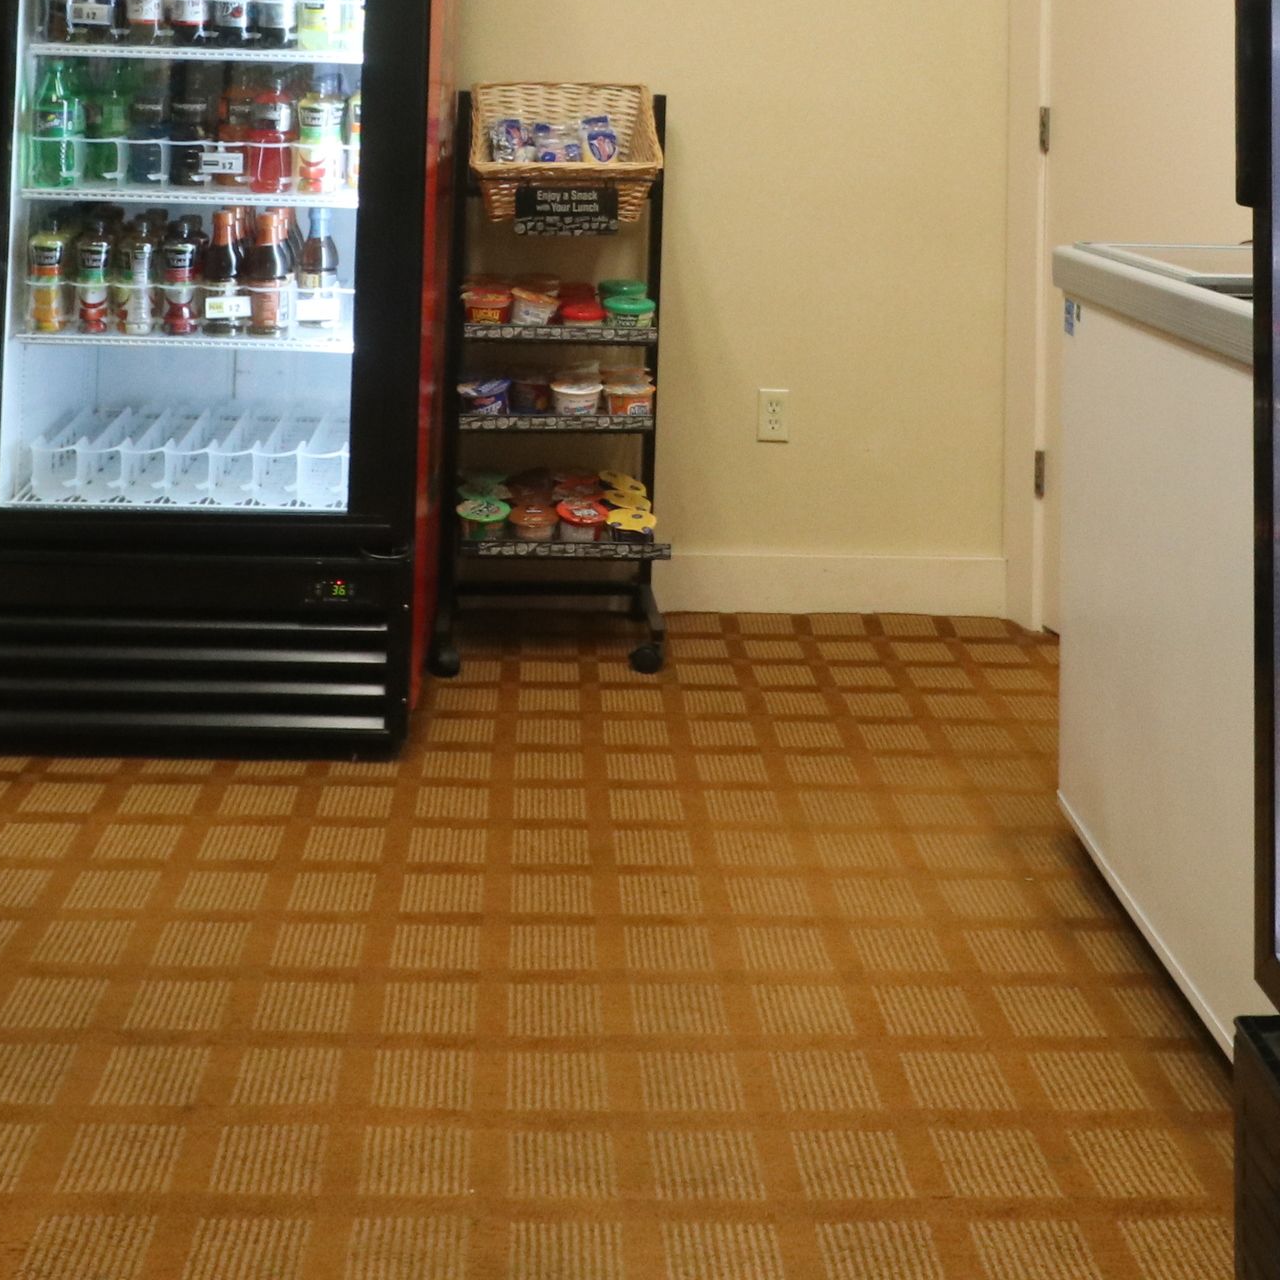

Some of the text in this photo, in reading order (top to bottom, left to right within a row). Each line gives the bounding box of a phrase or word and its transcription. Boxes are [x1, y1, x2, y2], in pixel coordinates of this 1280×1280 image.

[536, 190, 560, 202] Enjoy
[571, 190, 598, 200] Snack
[552, 202, 571, 212] Your
[572, 202, 599, 212] Lunch
[332, 584, 346, 596] 36
